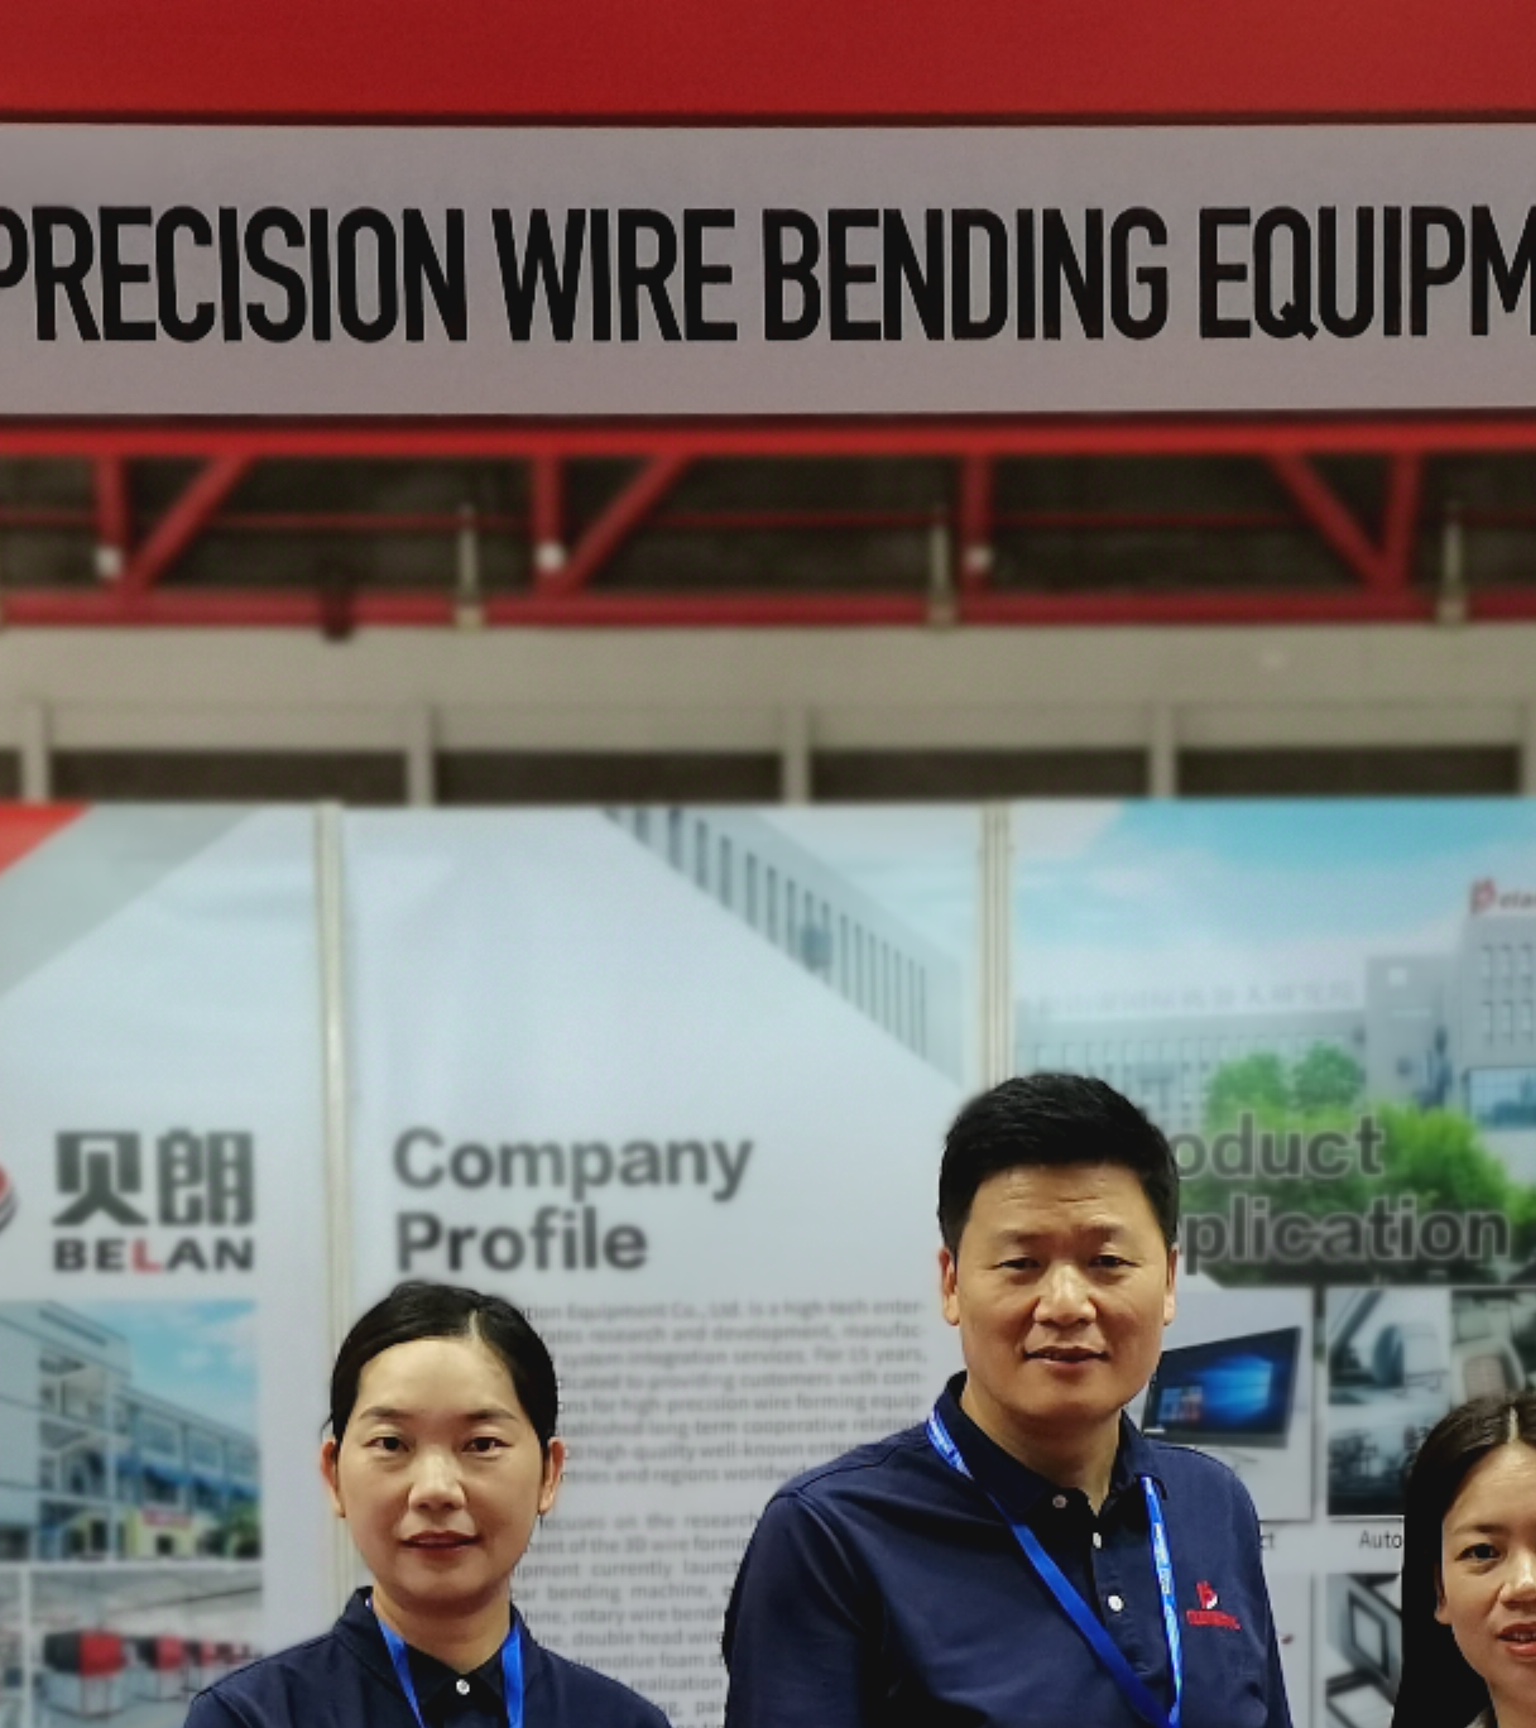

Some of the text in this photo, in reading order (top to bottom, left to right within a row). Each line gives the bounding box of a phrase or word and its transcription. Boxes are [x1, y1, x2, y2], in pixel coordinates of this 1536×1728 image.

[492, 206, 739, 342] WIRE
[763, 205, 1170, 342] BENDING
[52, 1128, 254, 1227] 贝朗
[393, 1125, 754, 1202] Company
[1175, 1112, 1385, 1180] oduct
[53, 1236, 254, 1274] BELAN
[395, 1202, 648, 1273] Profile
[1182, 1195, 1511, 1276] plication
